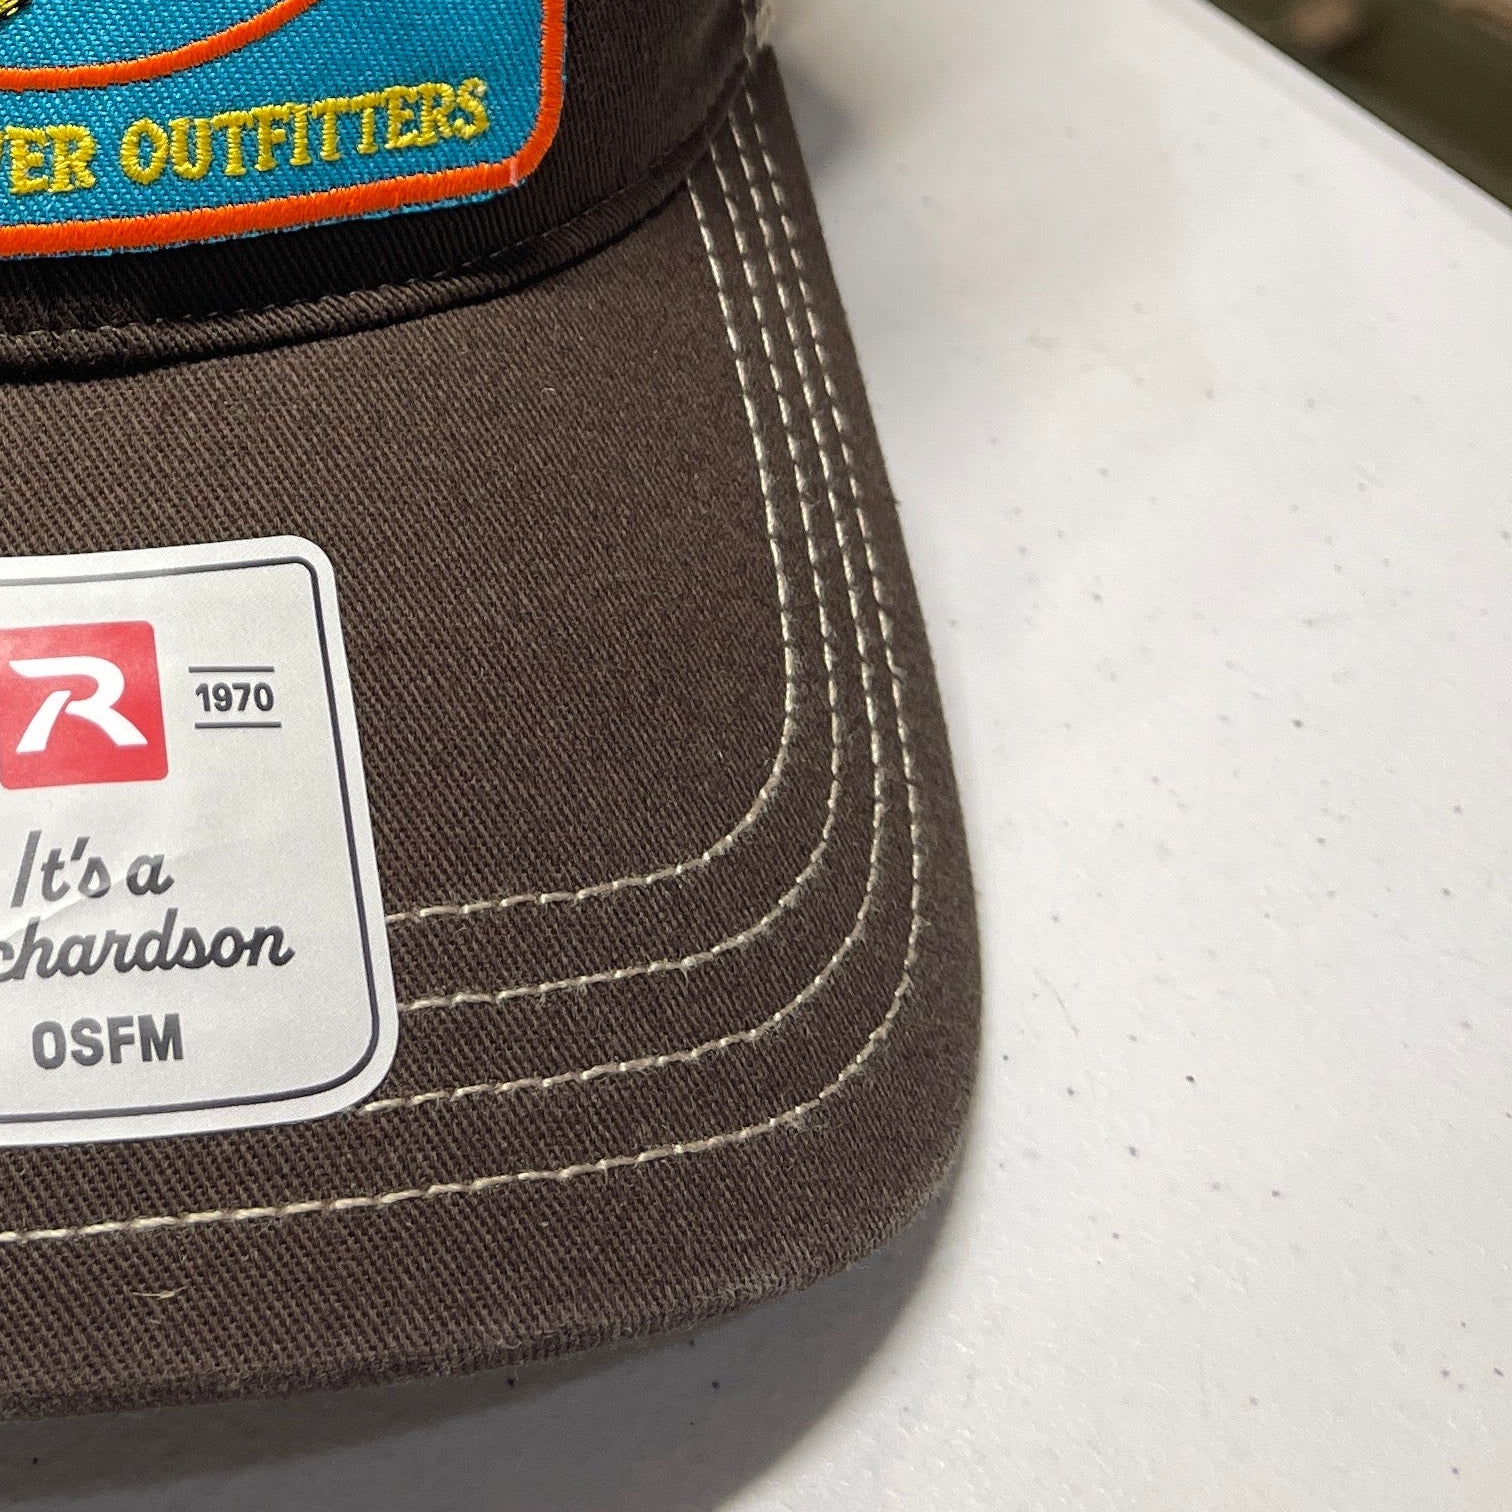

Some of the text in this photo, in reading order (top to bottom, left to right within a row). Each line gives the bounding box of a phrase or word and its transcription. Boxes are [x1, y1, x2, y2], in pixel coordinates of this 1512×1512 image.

[122, 77, 489, 185] OUTFITTERS
[194, 681, 275, 714] 1970
[10, 829, 175, 909] It's a
[31, 1012, 185, 1070] OSFM
